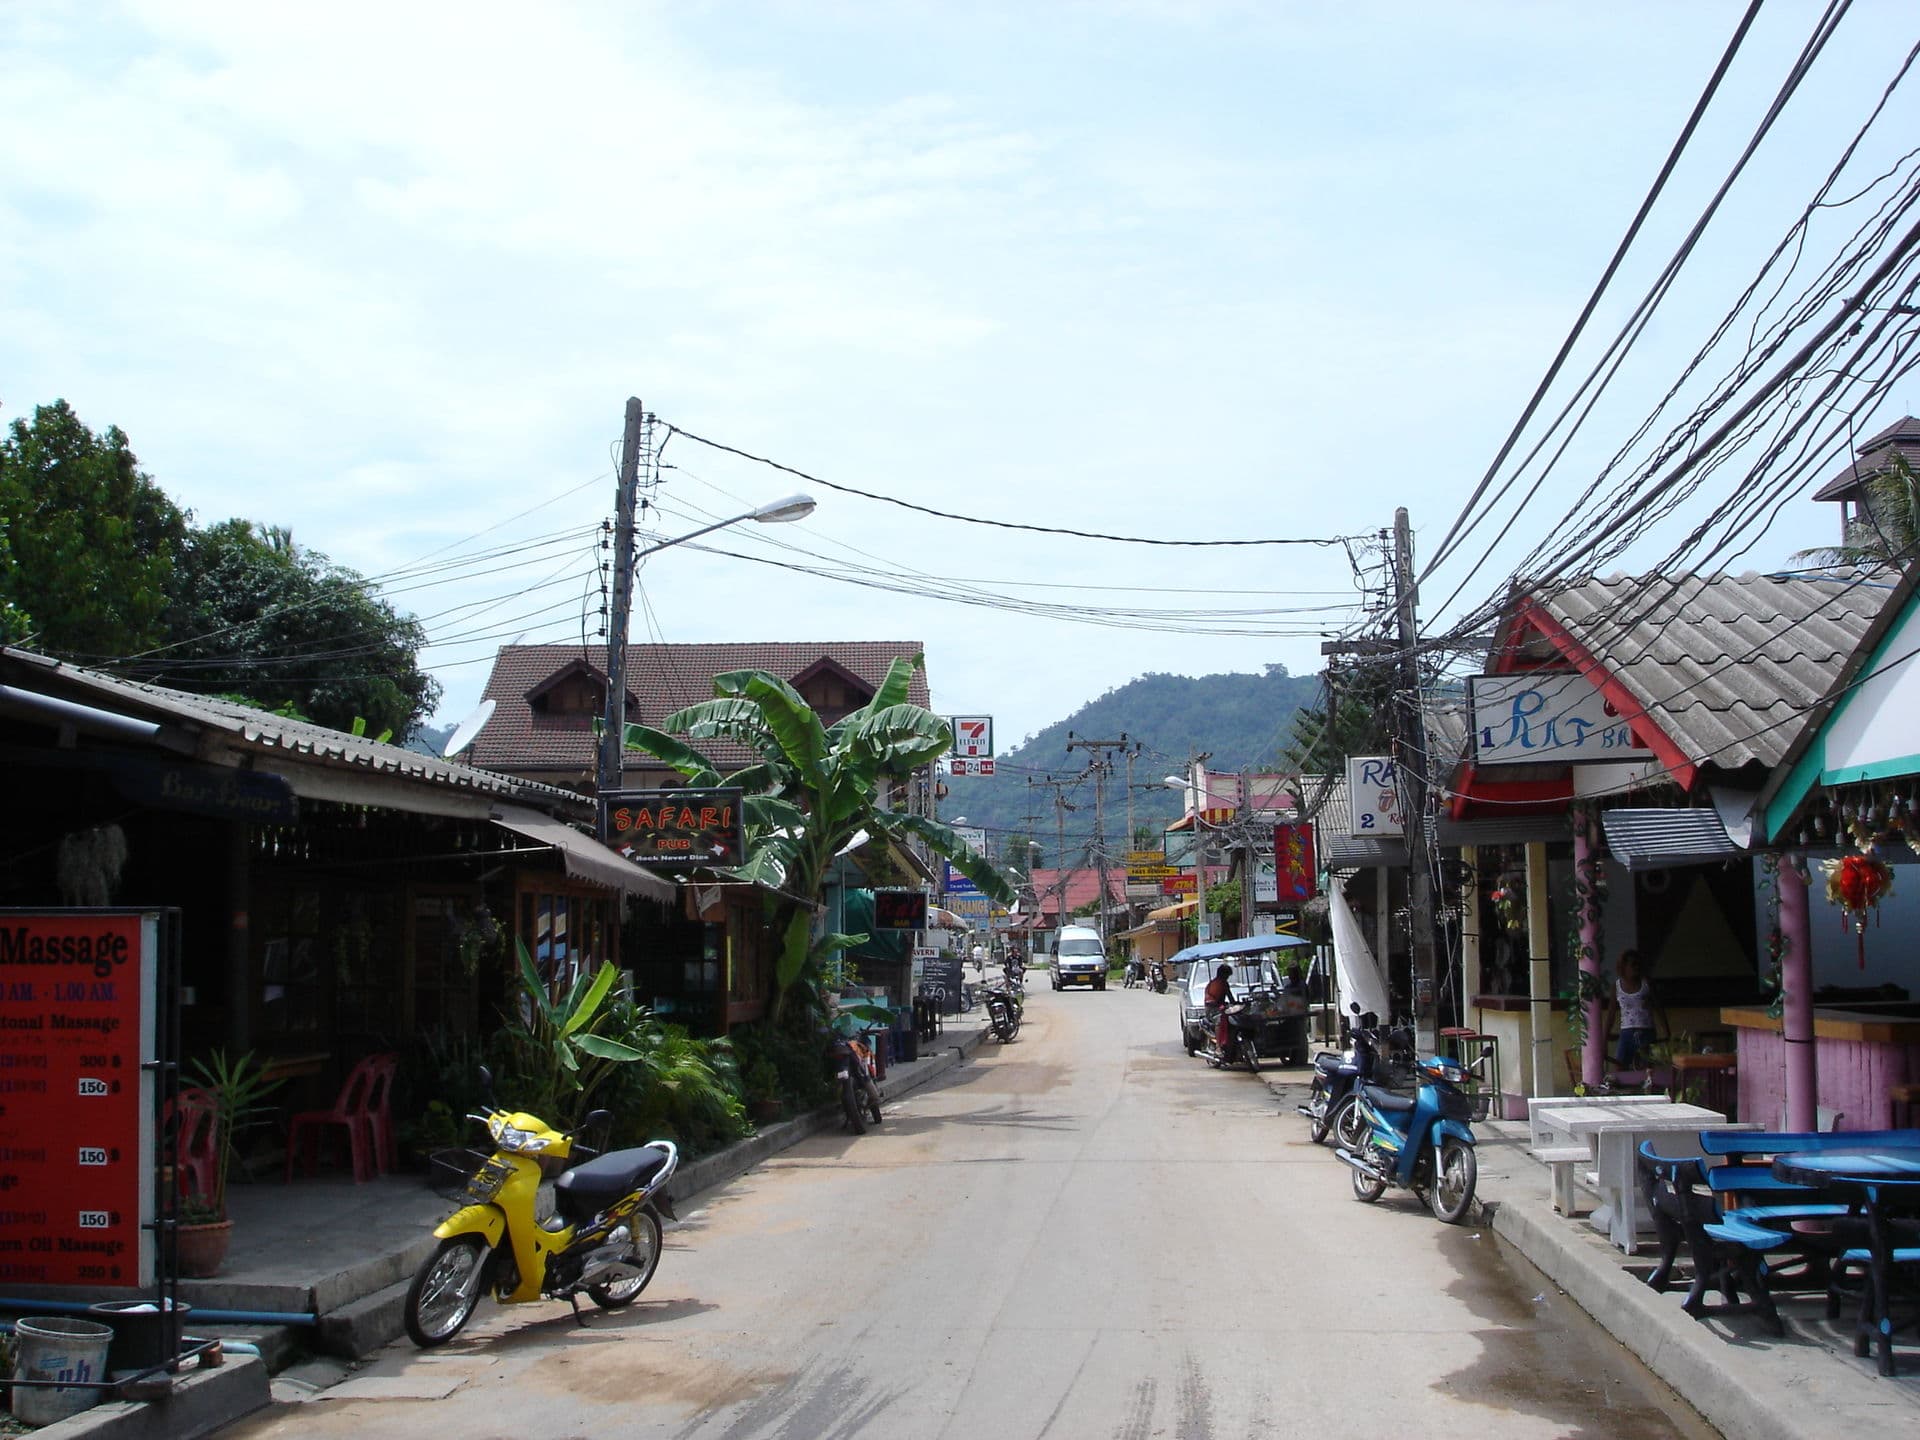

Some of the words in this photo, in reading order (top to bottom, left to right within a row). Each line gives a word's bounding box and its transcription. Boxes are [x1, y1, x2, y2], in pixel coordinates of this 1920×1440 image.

[960, 722, 985, 738] 7
[1480, 726, 1495, 748] 1
[1601, 727, 1632, 748] BA
[967, 762, 980, 773] 24
[1360, 760, 1396, 788] RA
[614, 806, 731, 831] SAFARI
[1361, 813, 1375, 829] 2
[657, 839, 691, 850] PUB
[635, 854, 659, 862] Rock
[0, 927, 128, 977] Massage
[912, 948, 935, 956] AVERN
[54, 983, 85, 1001] 1.00
[51, 1013, 120, 1033] Massage
[80, 1080, 106, 1094] 150
[80, 1151, 106, 1163] 150
[81, 1214, 106, 1226] 150
[29, 1236, 52, 1250] Oil
[58, 1237, 123, 1255] Massage
